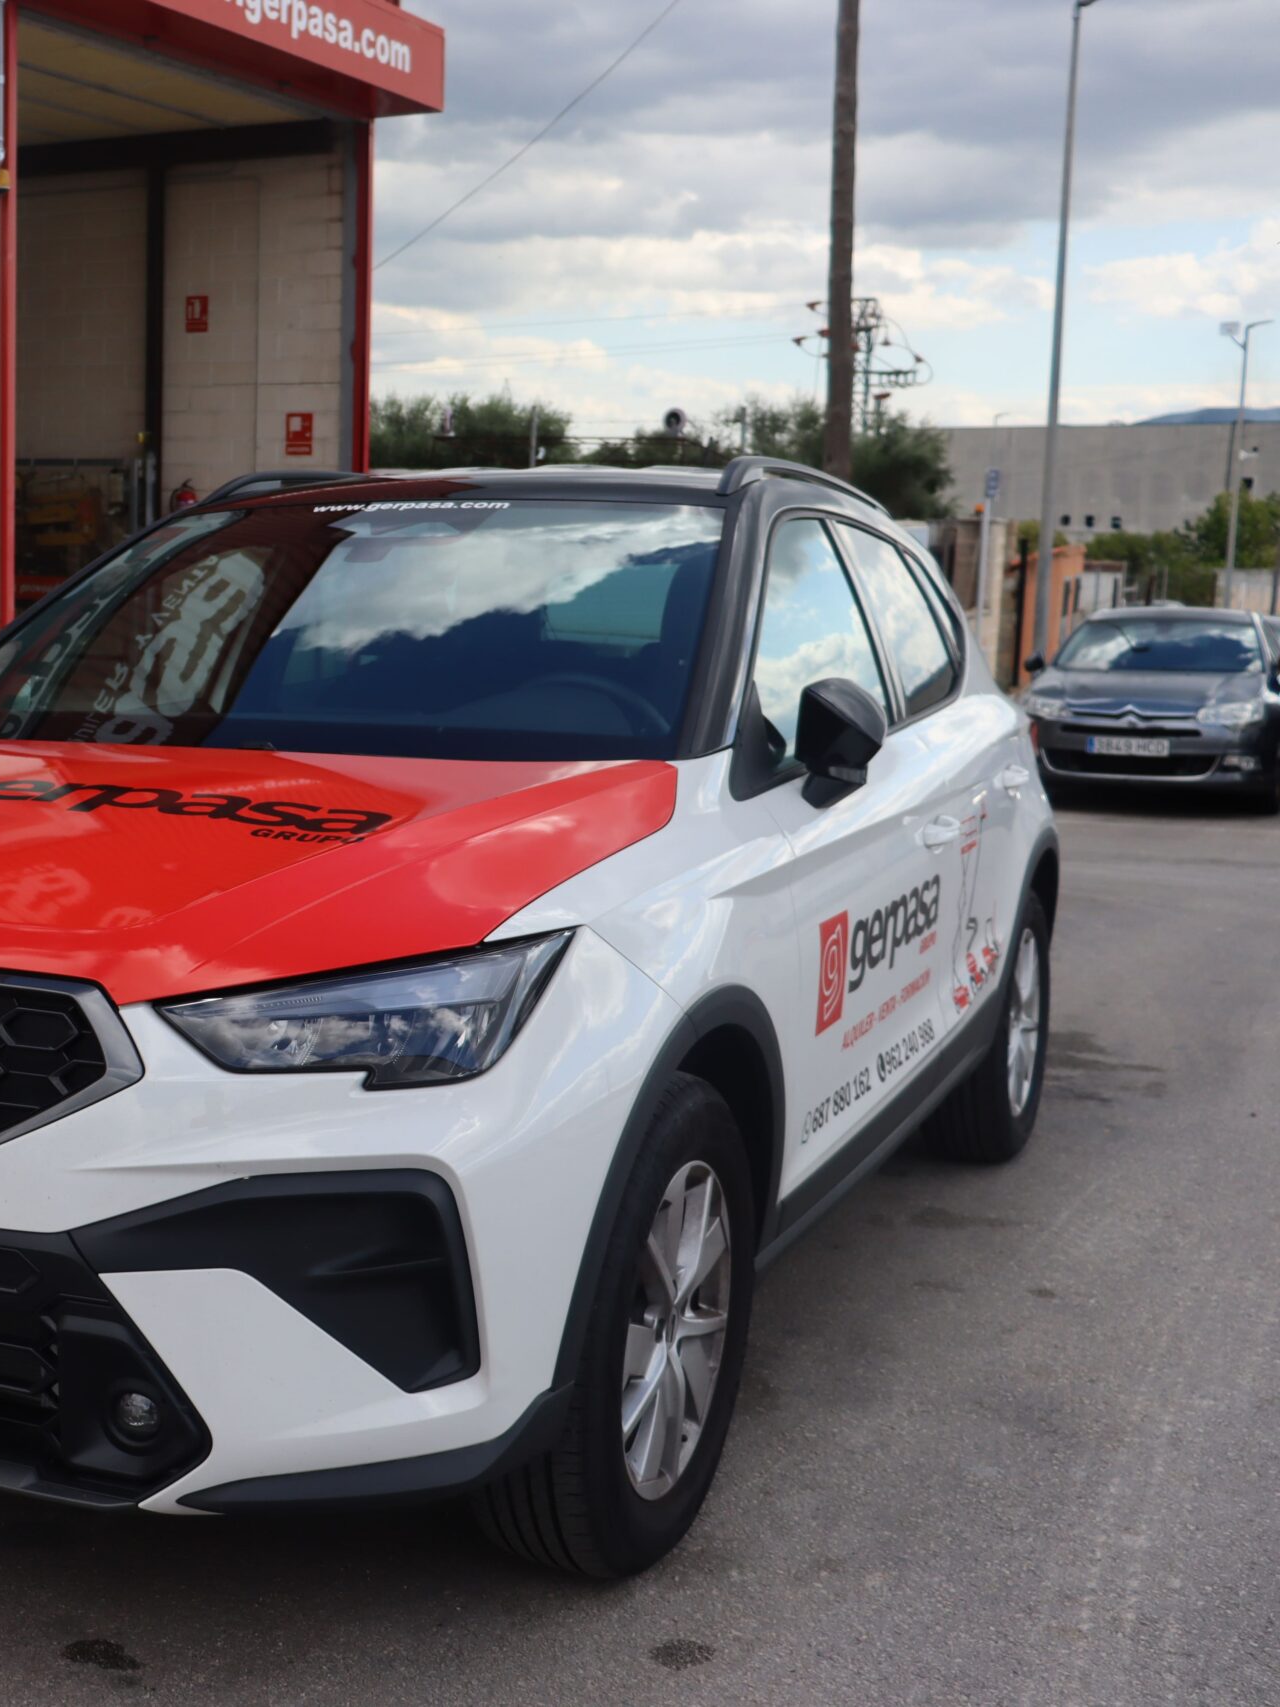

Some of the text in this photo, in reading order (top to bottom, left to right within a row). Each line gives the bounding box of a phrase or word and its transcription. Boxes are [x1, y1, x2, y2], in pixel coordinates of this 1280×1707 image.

[224, 0, 412, 74] .gerpasa.com
[313, 501, 511, 513] www.gerpasa.com
[848, 874, 940, 993] gerpasa
[885, 1043, 904, 1075] 962
[902, 1030, 920, 1062] 240
[812, 1097, 831, 1133] 687
[853, 1067, 872, 1101] 162
